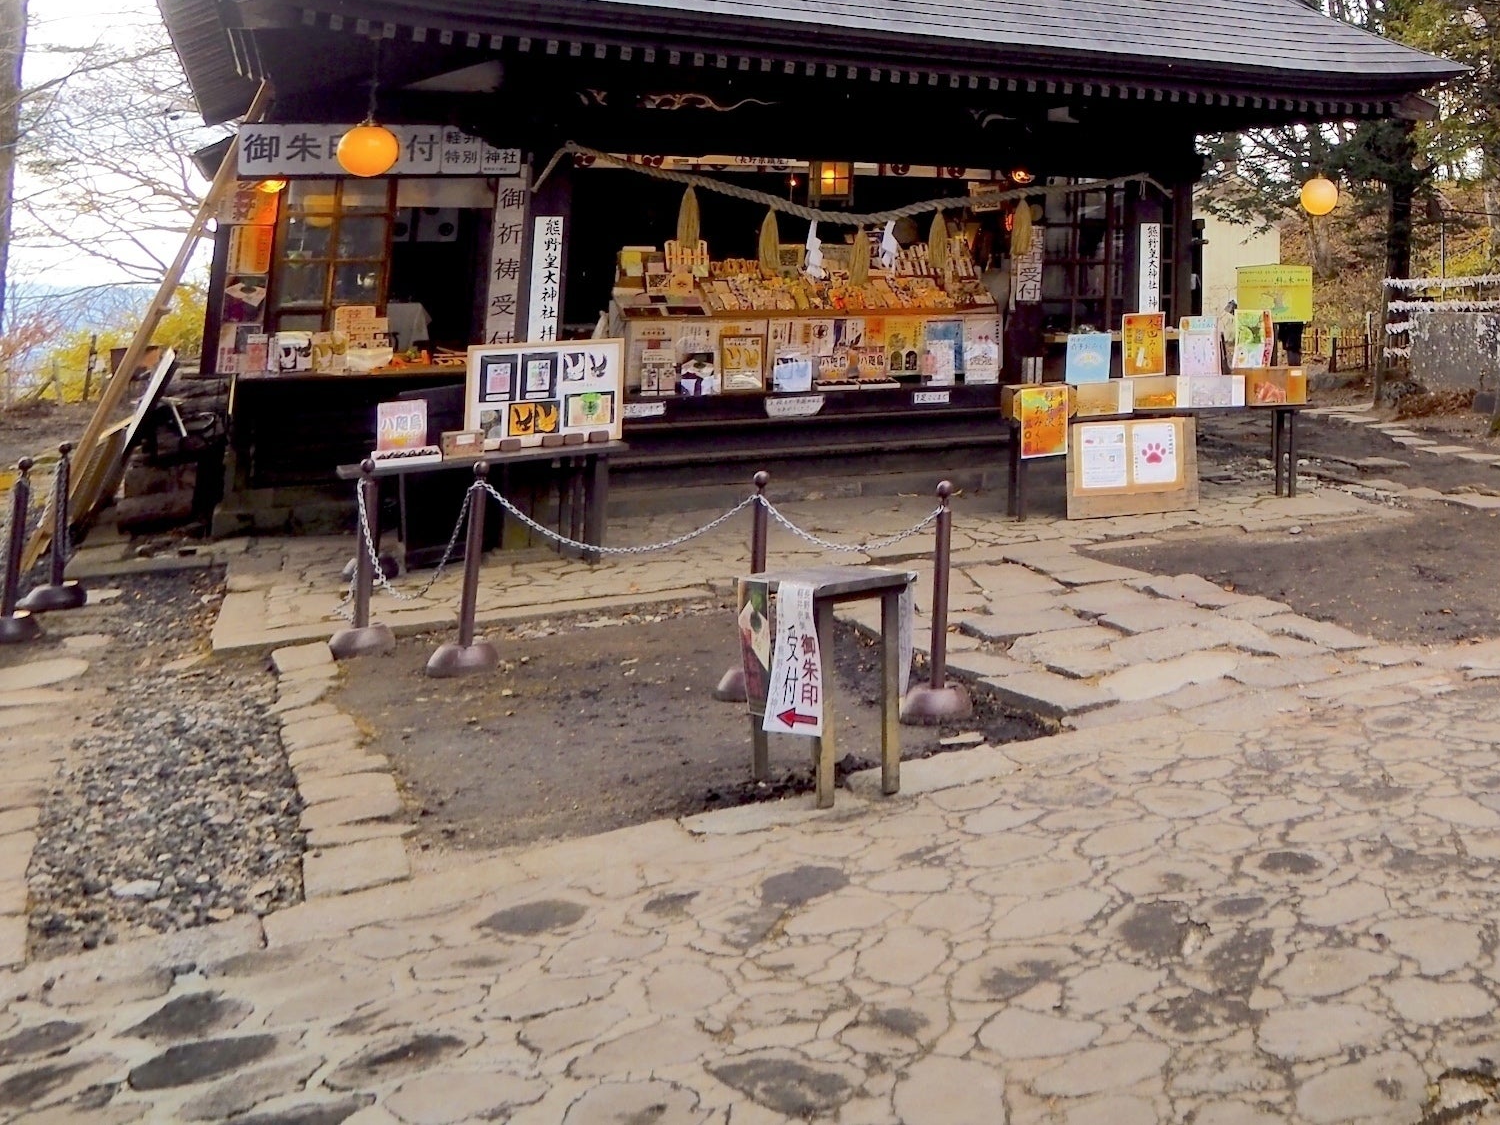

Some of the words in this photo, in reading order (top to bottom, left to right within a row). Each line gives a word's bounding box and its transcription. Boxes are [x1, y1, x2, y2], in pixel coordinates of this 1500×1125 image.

[243, 132, 440, 164] 御朱付
[539, 218, 562, 320] 熊野皇大神社
[783, 624, 799, 706] 受付
[801, 633, 819, 707] 御朱印
